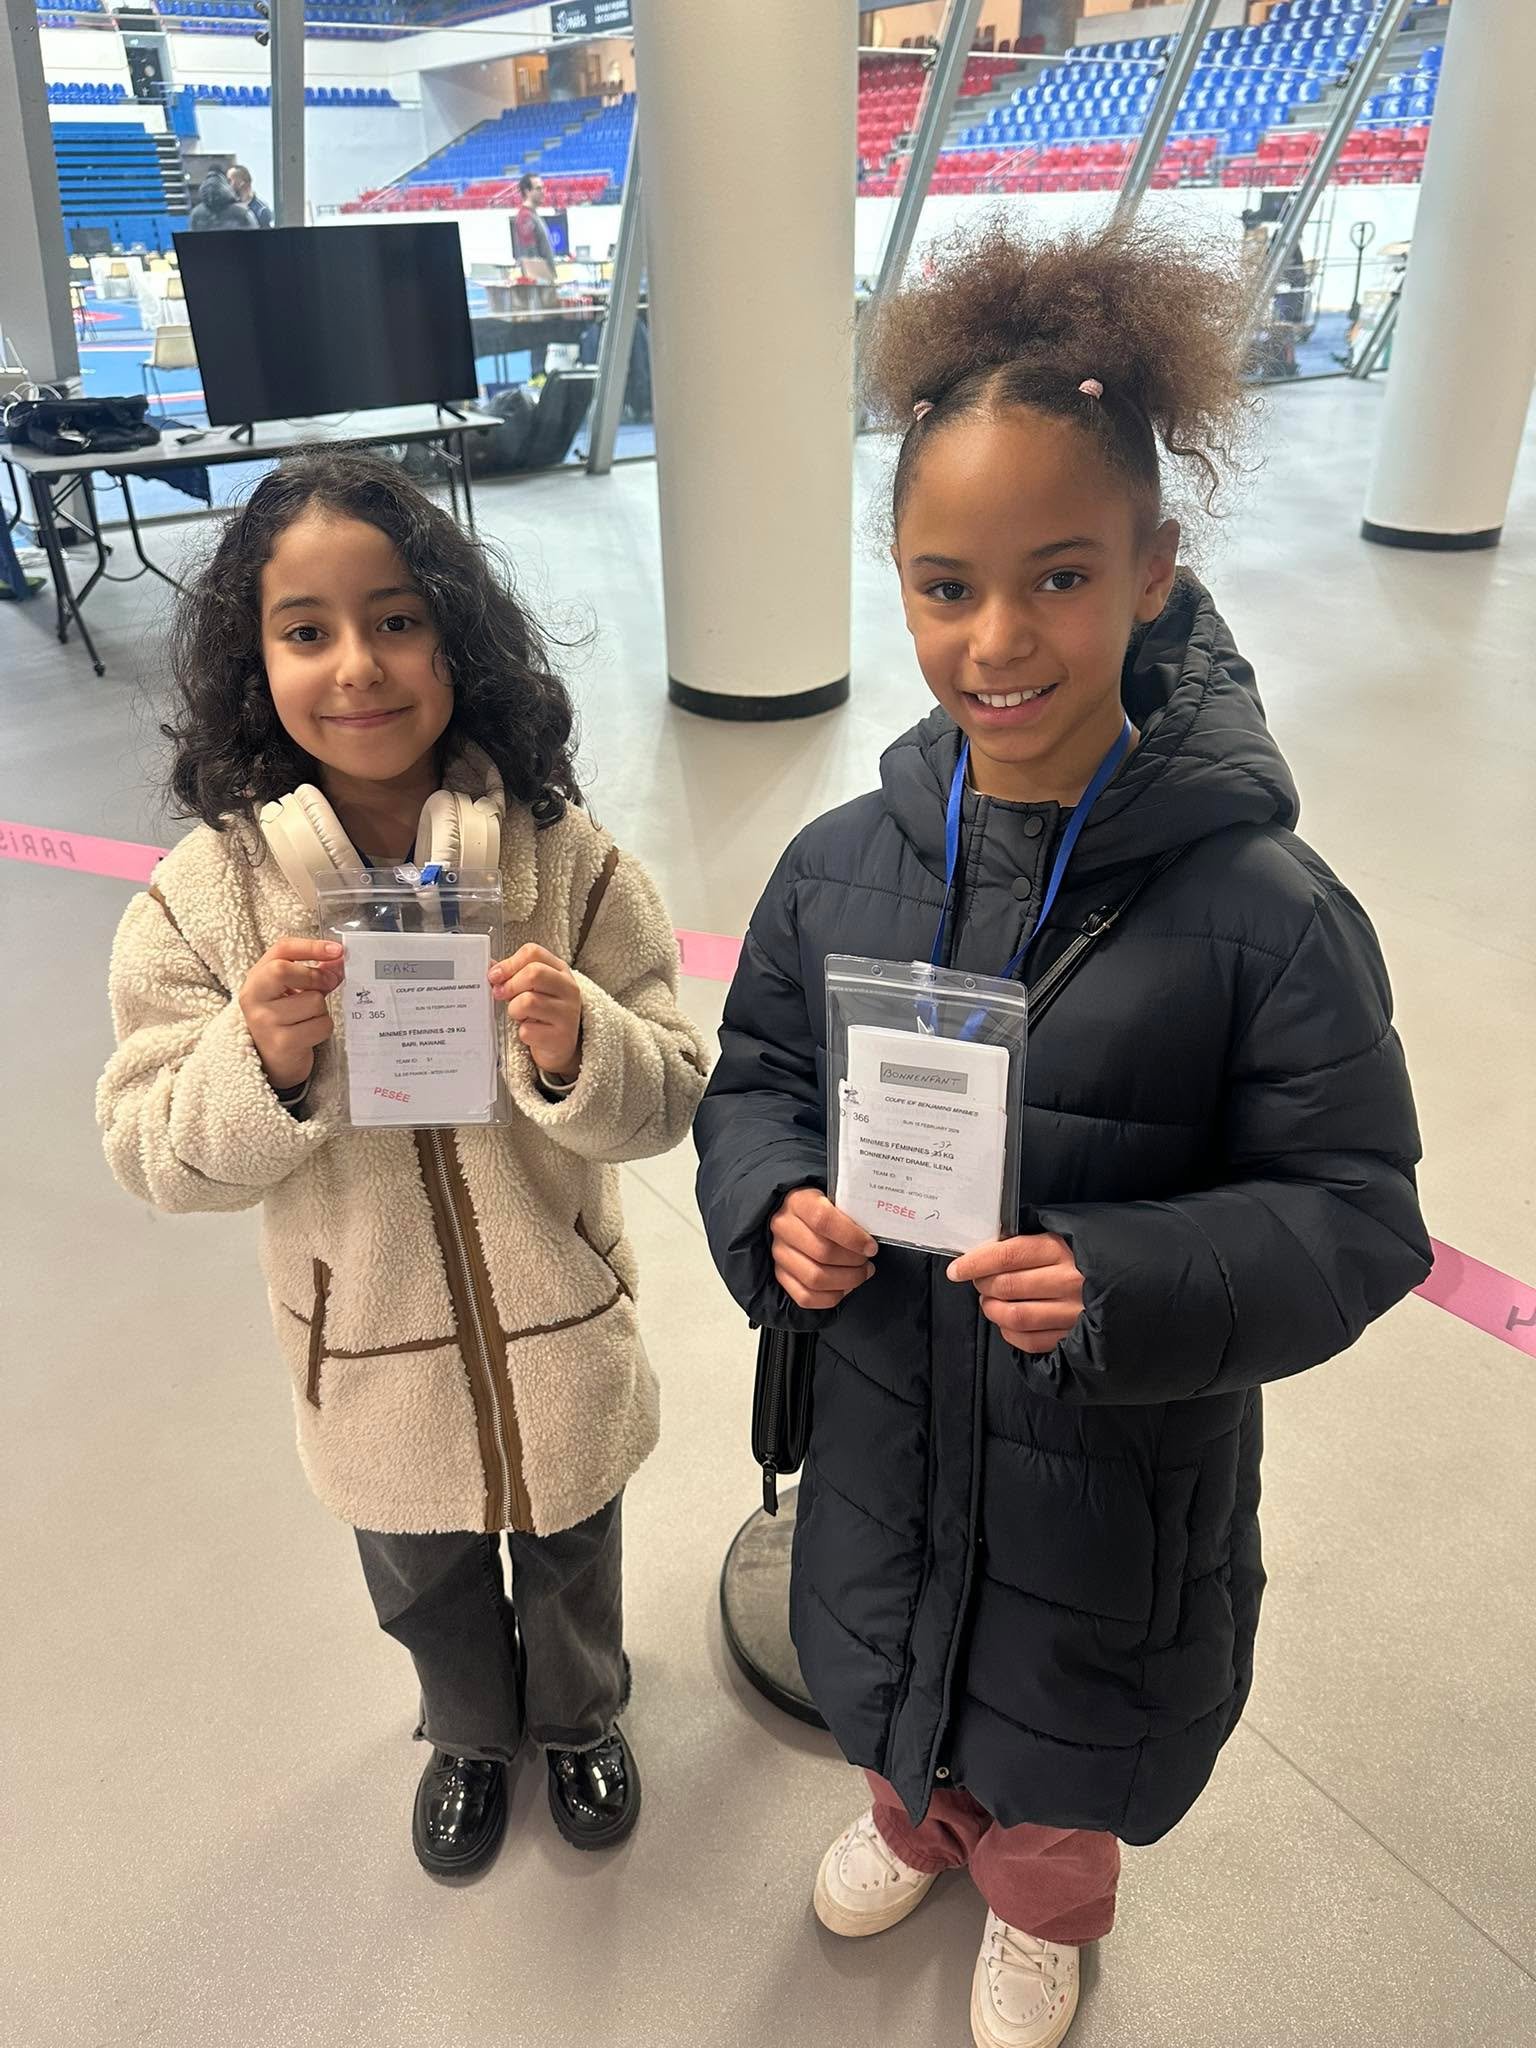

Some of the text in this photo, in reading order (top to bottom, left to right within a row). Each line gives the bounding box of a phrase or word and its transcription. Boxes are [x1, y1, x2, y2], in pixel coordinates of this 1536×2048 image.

[369, 1010, 385, 1019] 365
[379, 1030, 407, 1038] MINIMES
[883, 1068, 963, 1087] BONNENFANT
[374, 1086, 411, 1103] PESÉE
[884, 1096, 906, 1105] COUPE
[917, 1101, 952, 1112] BENJAMINS
[952, 1107, 979, 1117] MINIMES
[853, 1111, 870, 1124] 366
[920, 1122, 948, 1131] FEBRUARY
[860, 1136, 890, 1148] MINIMES
[890, 1142, 930, 1155] FÉMININES
[943, 1151, 954, 1160] KG
[860, 1149, 904, 1163] BONNENFANT
[932, 1162, 953, 1172] ILENA
[876, 1200, 917, 1220] PESÉE
